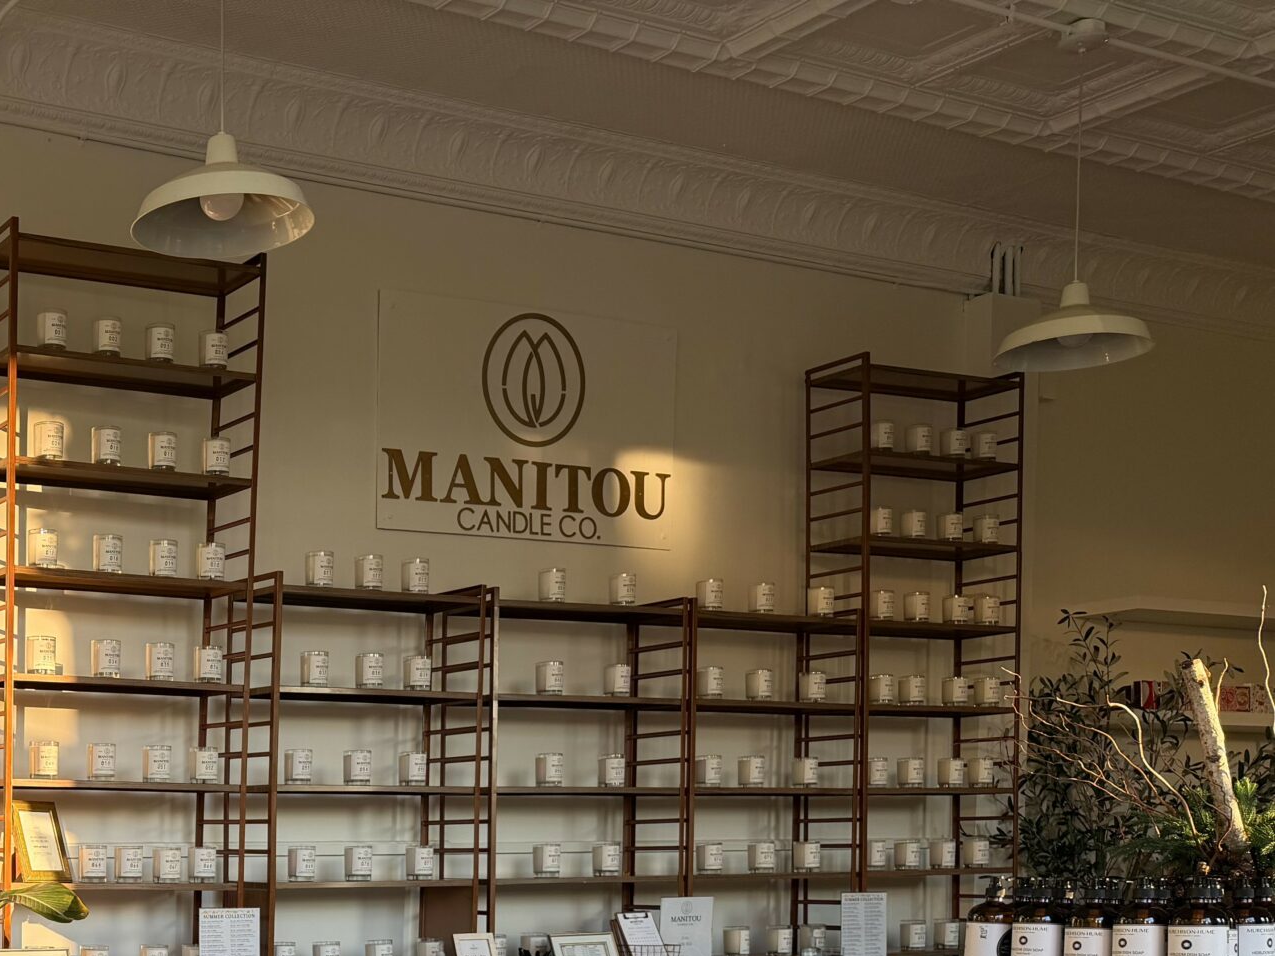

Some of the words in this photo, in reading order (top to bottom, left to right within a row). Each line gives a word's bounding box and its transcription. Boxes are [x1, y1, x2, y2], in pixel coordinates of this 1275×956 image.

[381, 447, 671, 520] MANITOU
[457, 507, 552, 536] CANDLE
[559, 514, 601, 540] CO.
[670, 915, 702, 923] MANITOU
